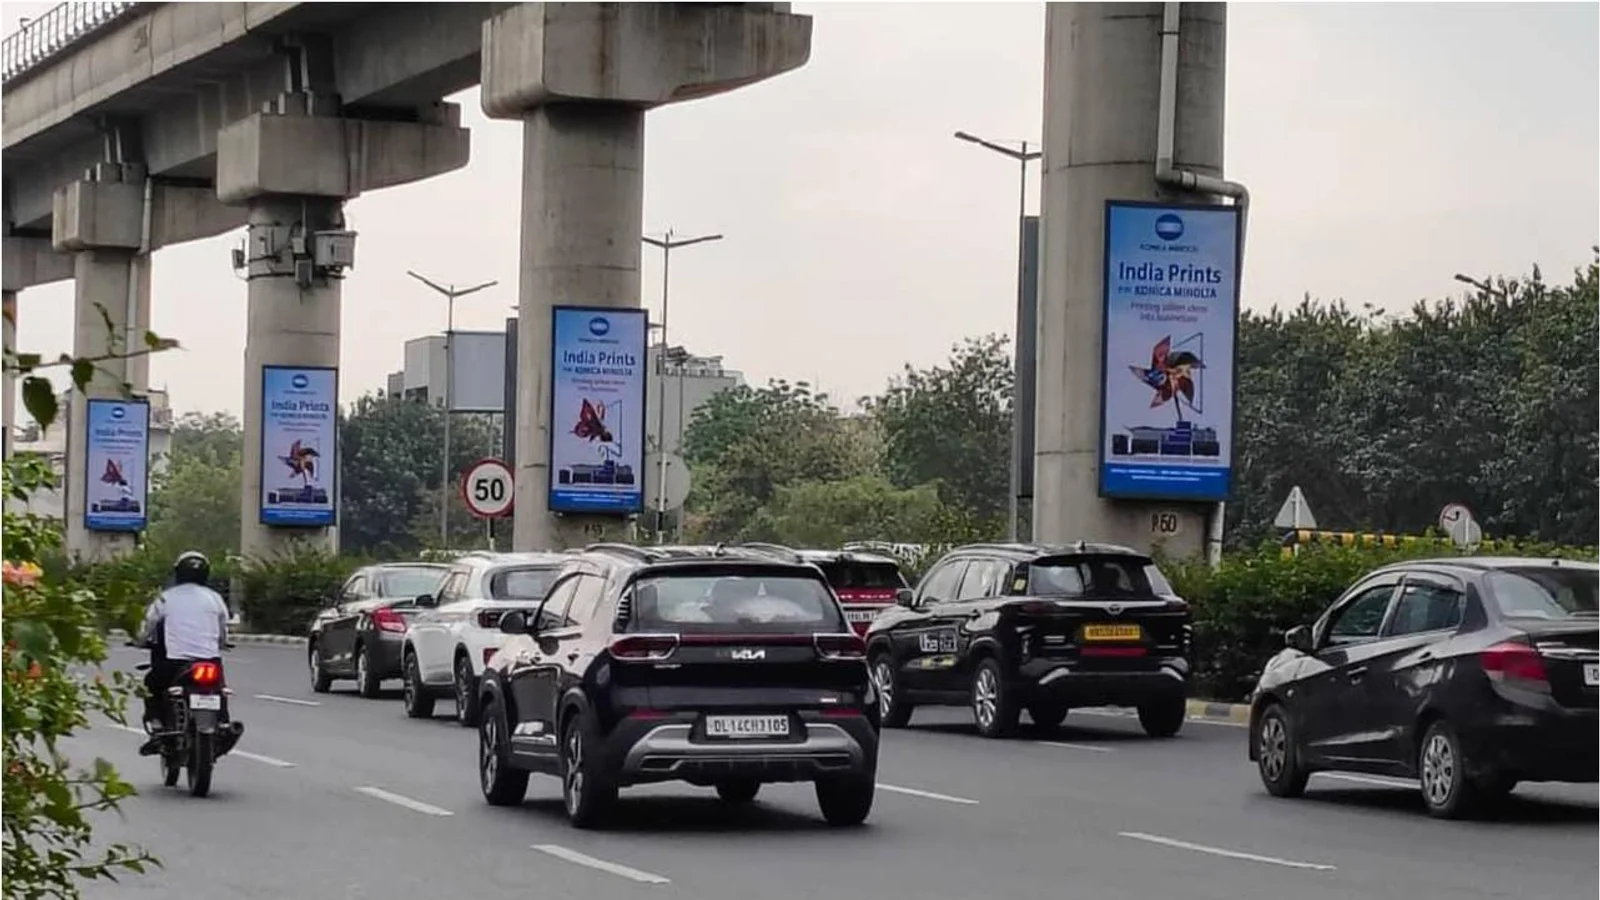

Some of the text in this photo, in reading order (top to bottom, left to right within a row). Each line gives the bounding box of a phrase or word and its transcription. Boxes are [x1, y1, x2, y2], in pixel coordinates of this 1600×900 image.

[1119, 261, 1222, 284] India Prints
[1134, 286, 1172, 297] KONICA
[1172, 287, 1217, 299] MINOLTA
[563, 350, 636, 366] India Prints
[271, 400, 330, 412] India Prints
[475, 478, 504, 501] 50
